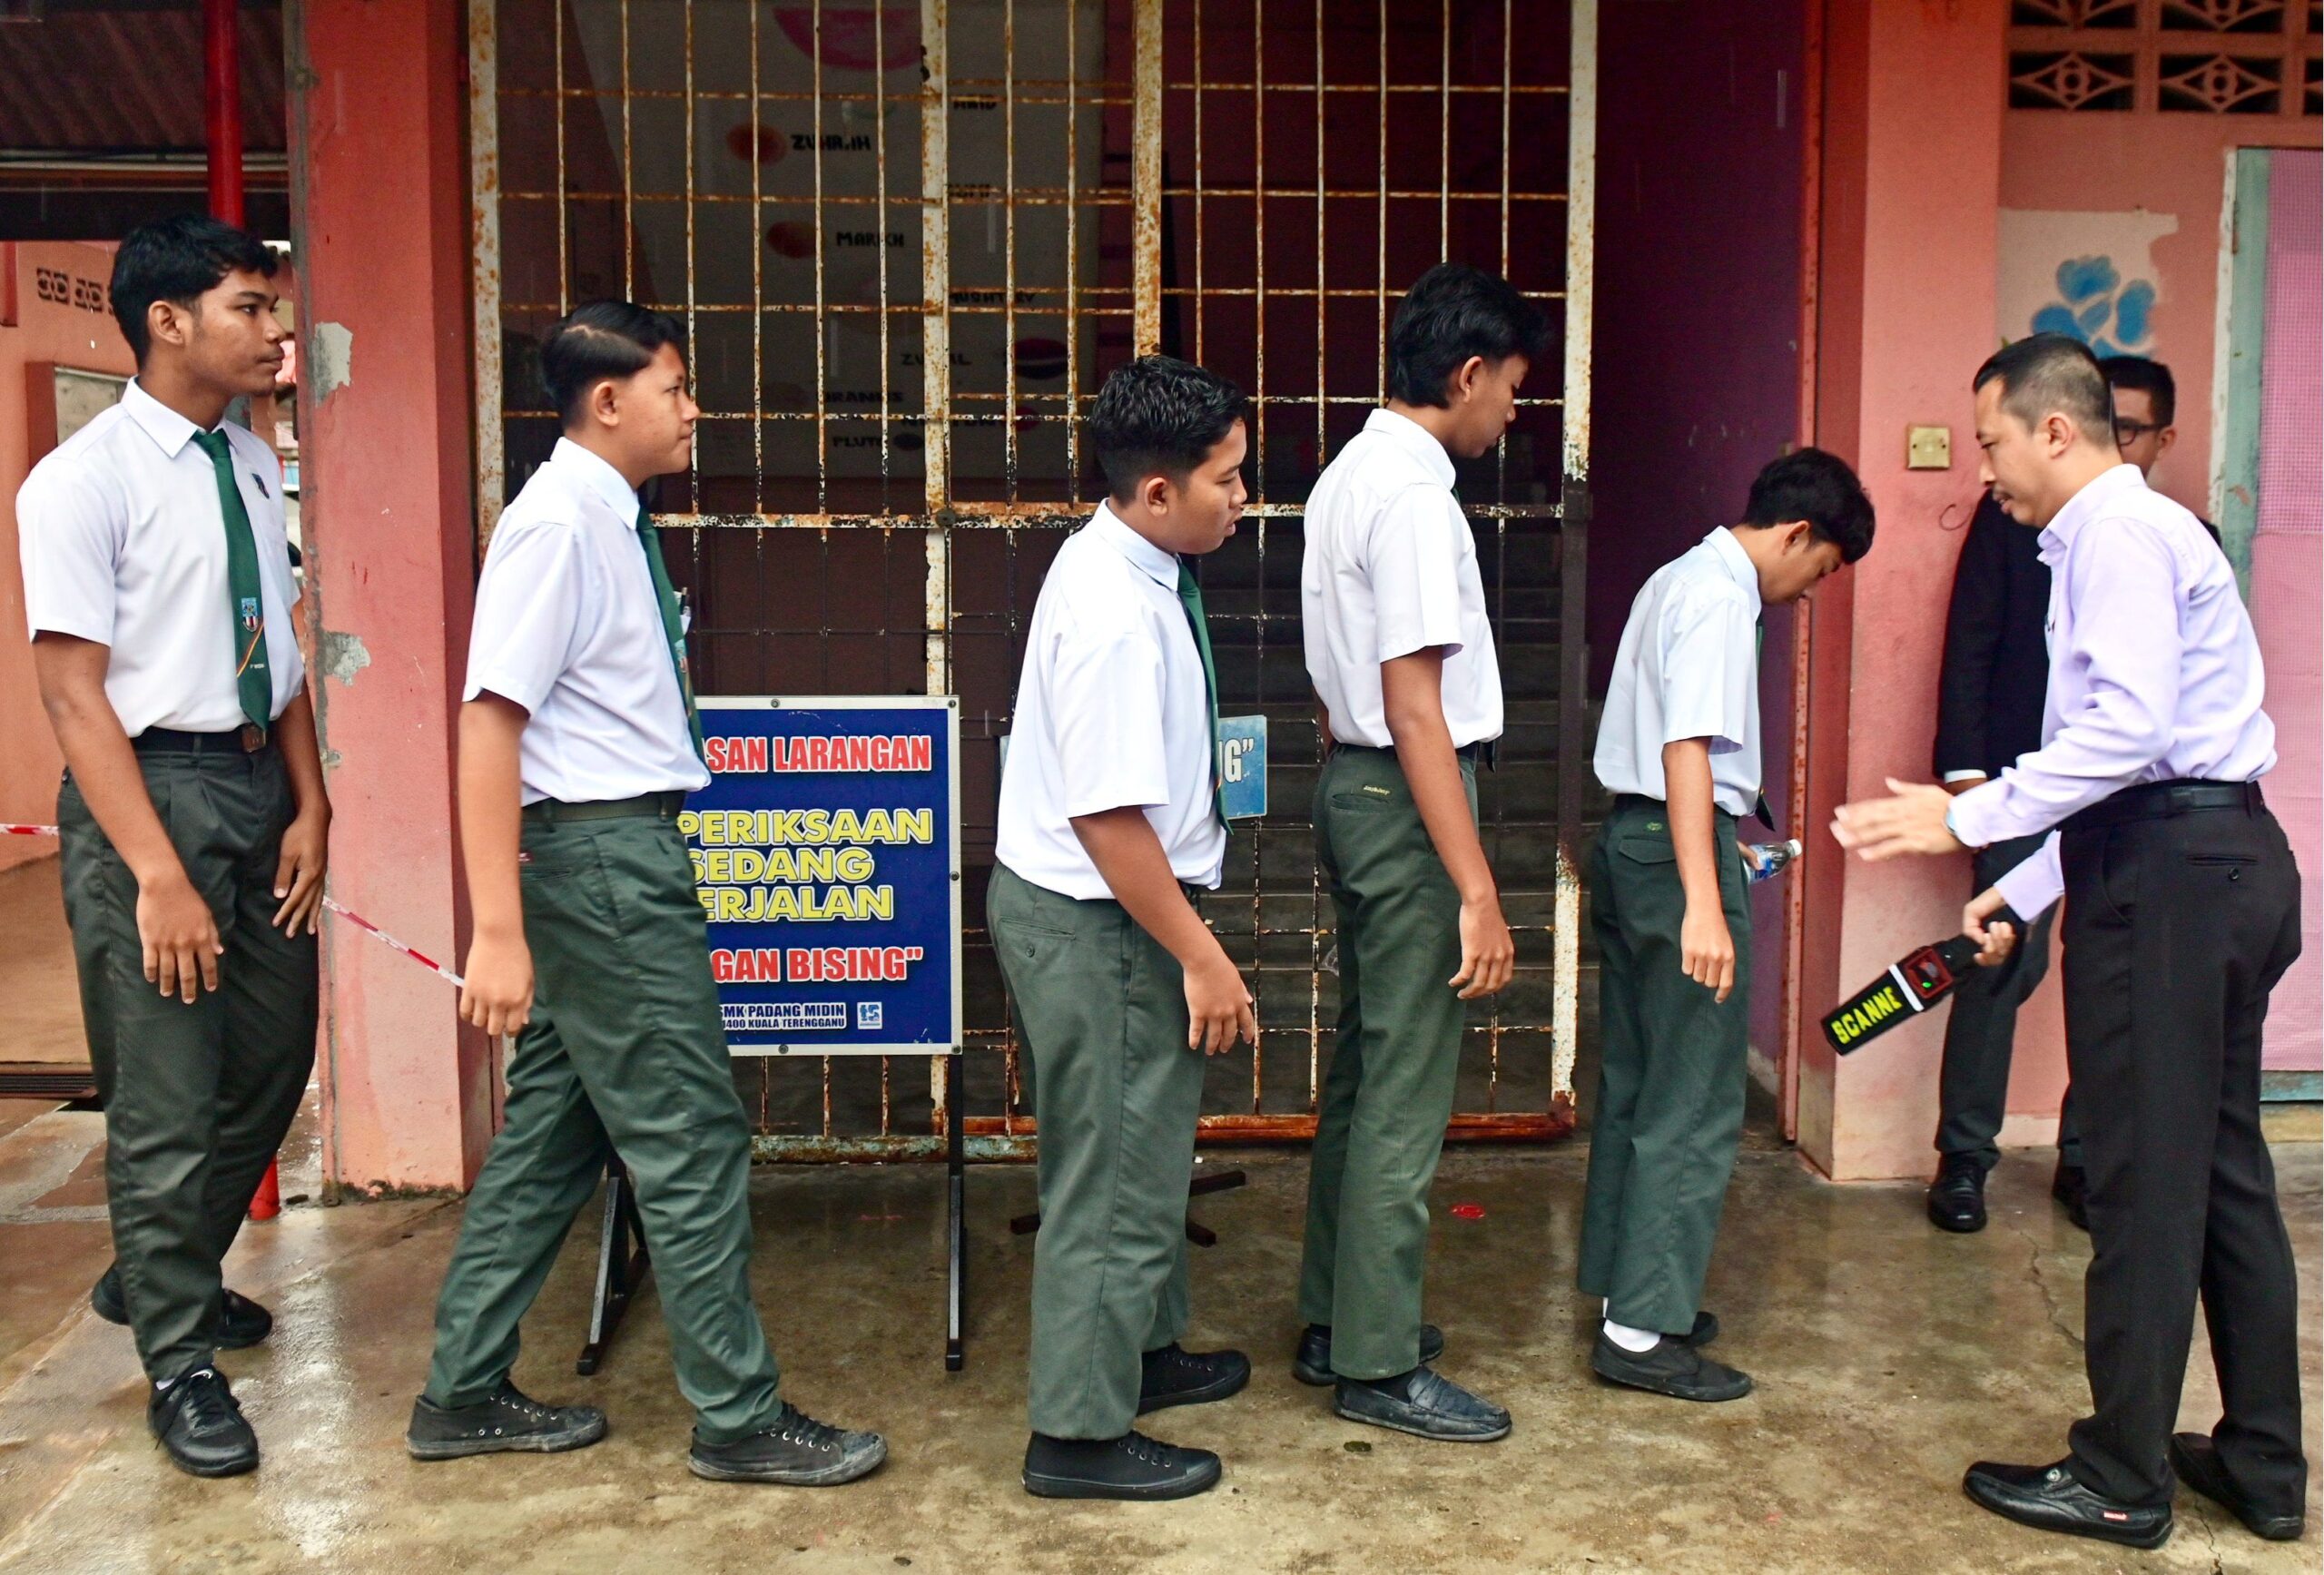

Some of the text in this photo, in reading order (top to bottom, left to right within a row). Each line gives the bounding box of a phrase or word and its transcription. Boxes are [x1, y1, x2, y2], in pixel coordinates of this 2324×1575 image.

[704, 735, 931, 773] SAN LARANGAN
[677, 808, 932, 845] PERIKSAAN
[688, 847, 874, 883] SEDANG
[787, 947, 922, 982] BISING"
[721, 1004, 844, 1018] MK PADANG MIDIN
[748, 1019, 780, 1029] KUALA
[782, 1018, 845, 1029] TERENGGANU
